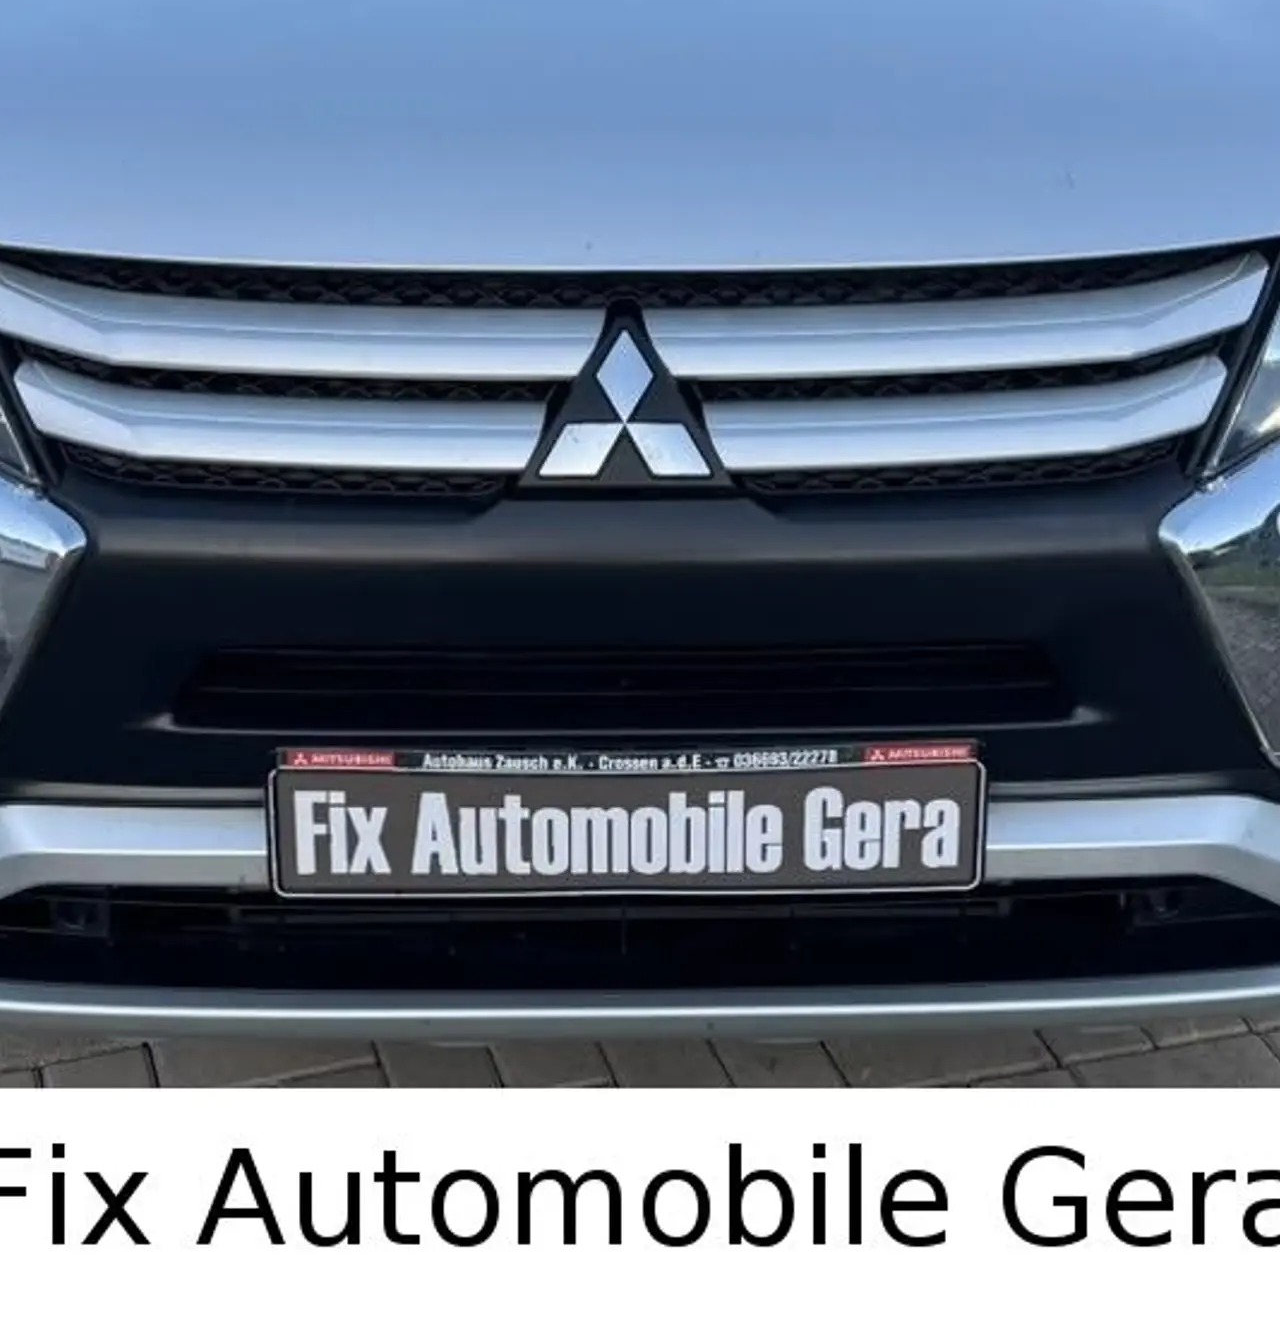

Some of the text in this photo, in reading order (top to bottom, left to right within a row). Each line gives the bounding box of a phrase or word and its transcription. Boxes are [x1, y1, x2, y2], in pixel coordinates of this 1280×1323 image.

[422, 753, 492, 770] Autohaus
[598, 754, 658, 771] Crossen
[293, 786, 960, 875] Fix Automobile Gera
